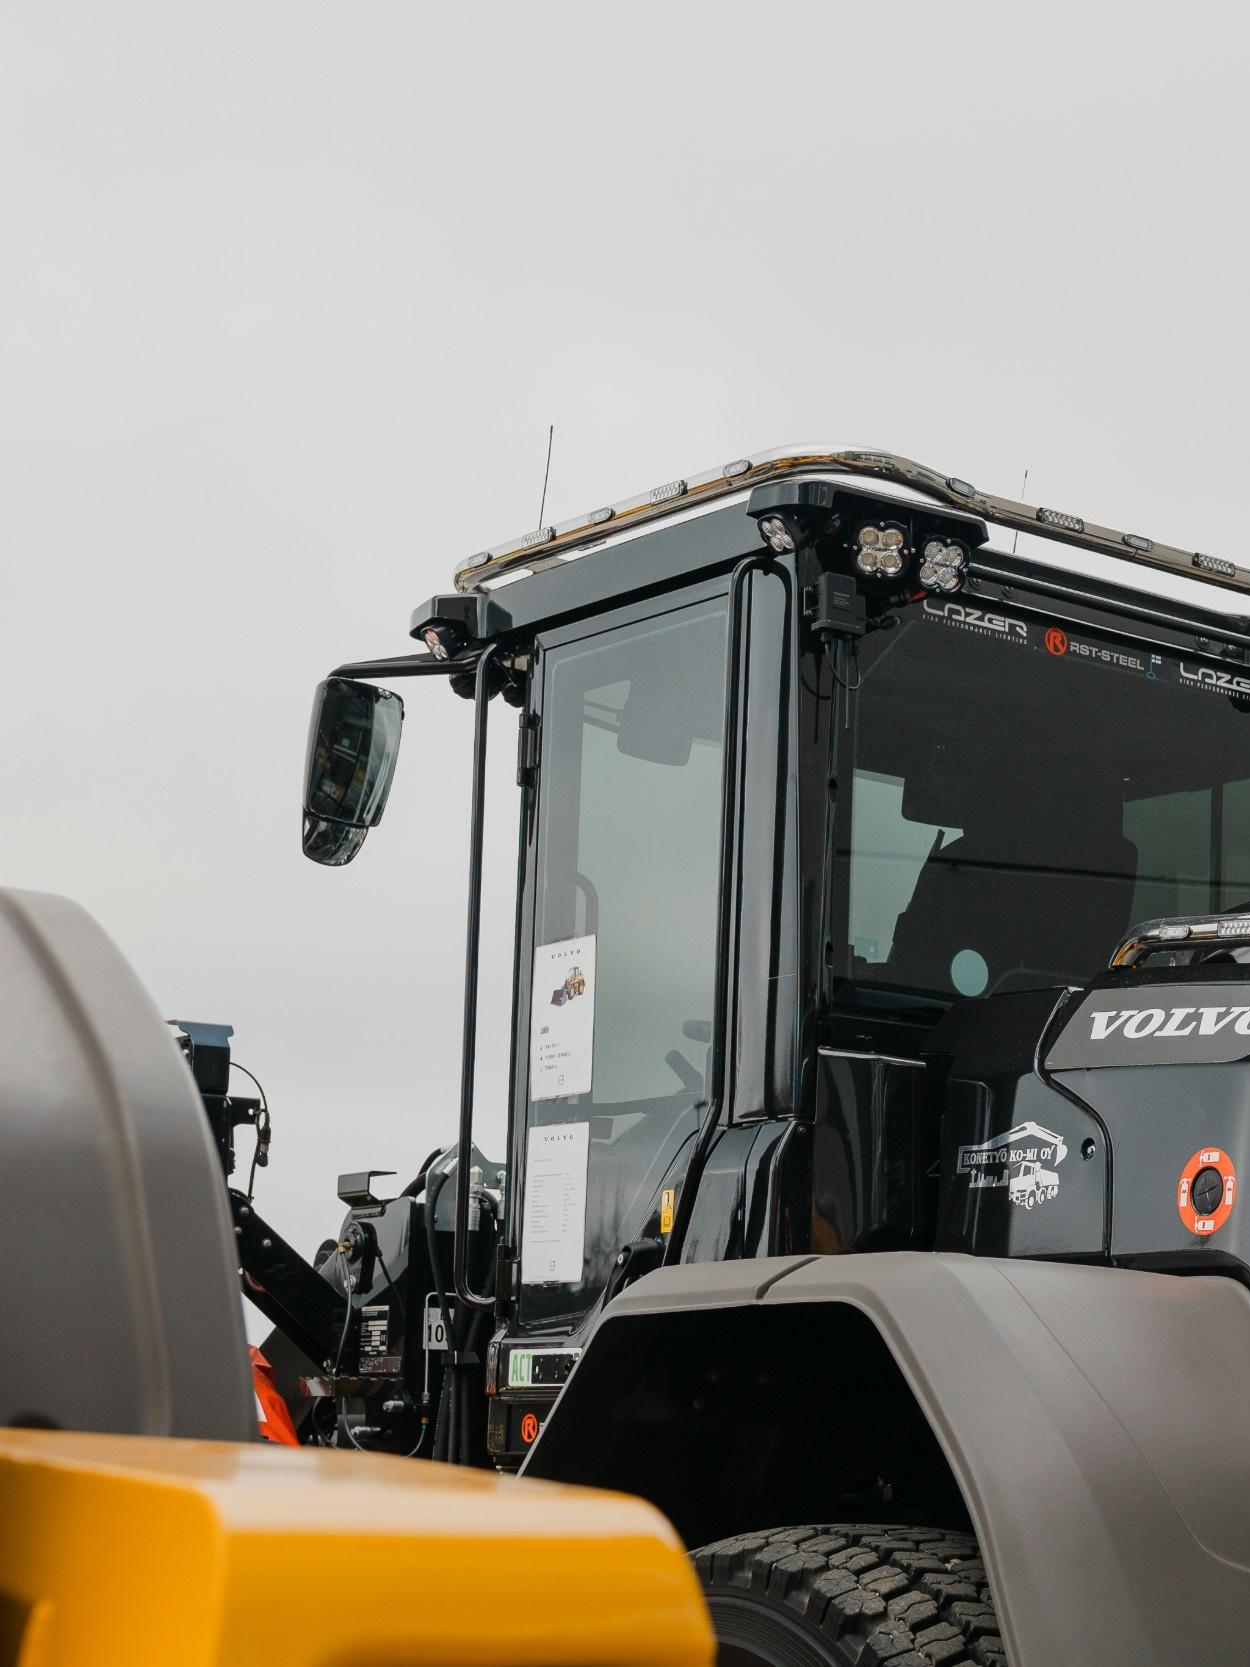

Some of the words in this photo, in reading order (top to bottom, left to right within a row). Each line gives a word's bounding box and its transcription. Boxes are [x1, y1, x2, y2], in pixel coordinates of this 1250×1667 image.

[923, 599, 1027, 637] LAZER
[1069, 641, 1144, 671] RST-STEEL
[544, 1134, 574, 1142] VOLVO
[1009, 1148, 1038, 1161] KO-MI
[1040, 1144, 1056, 1160] OY
